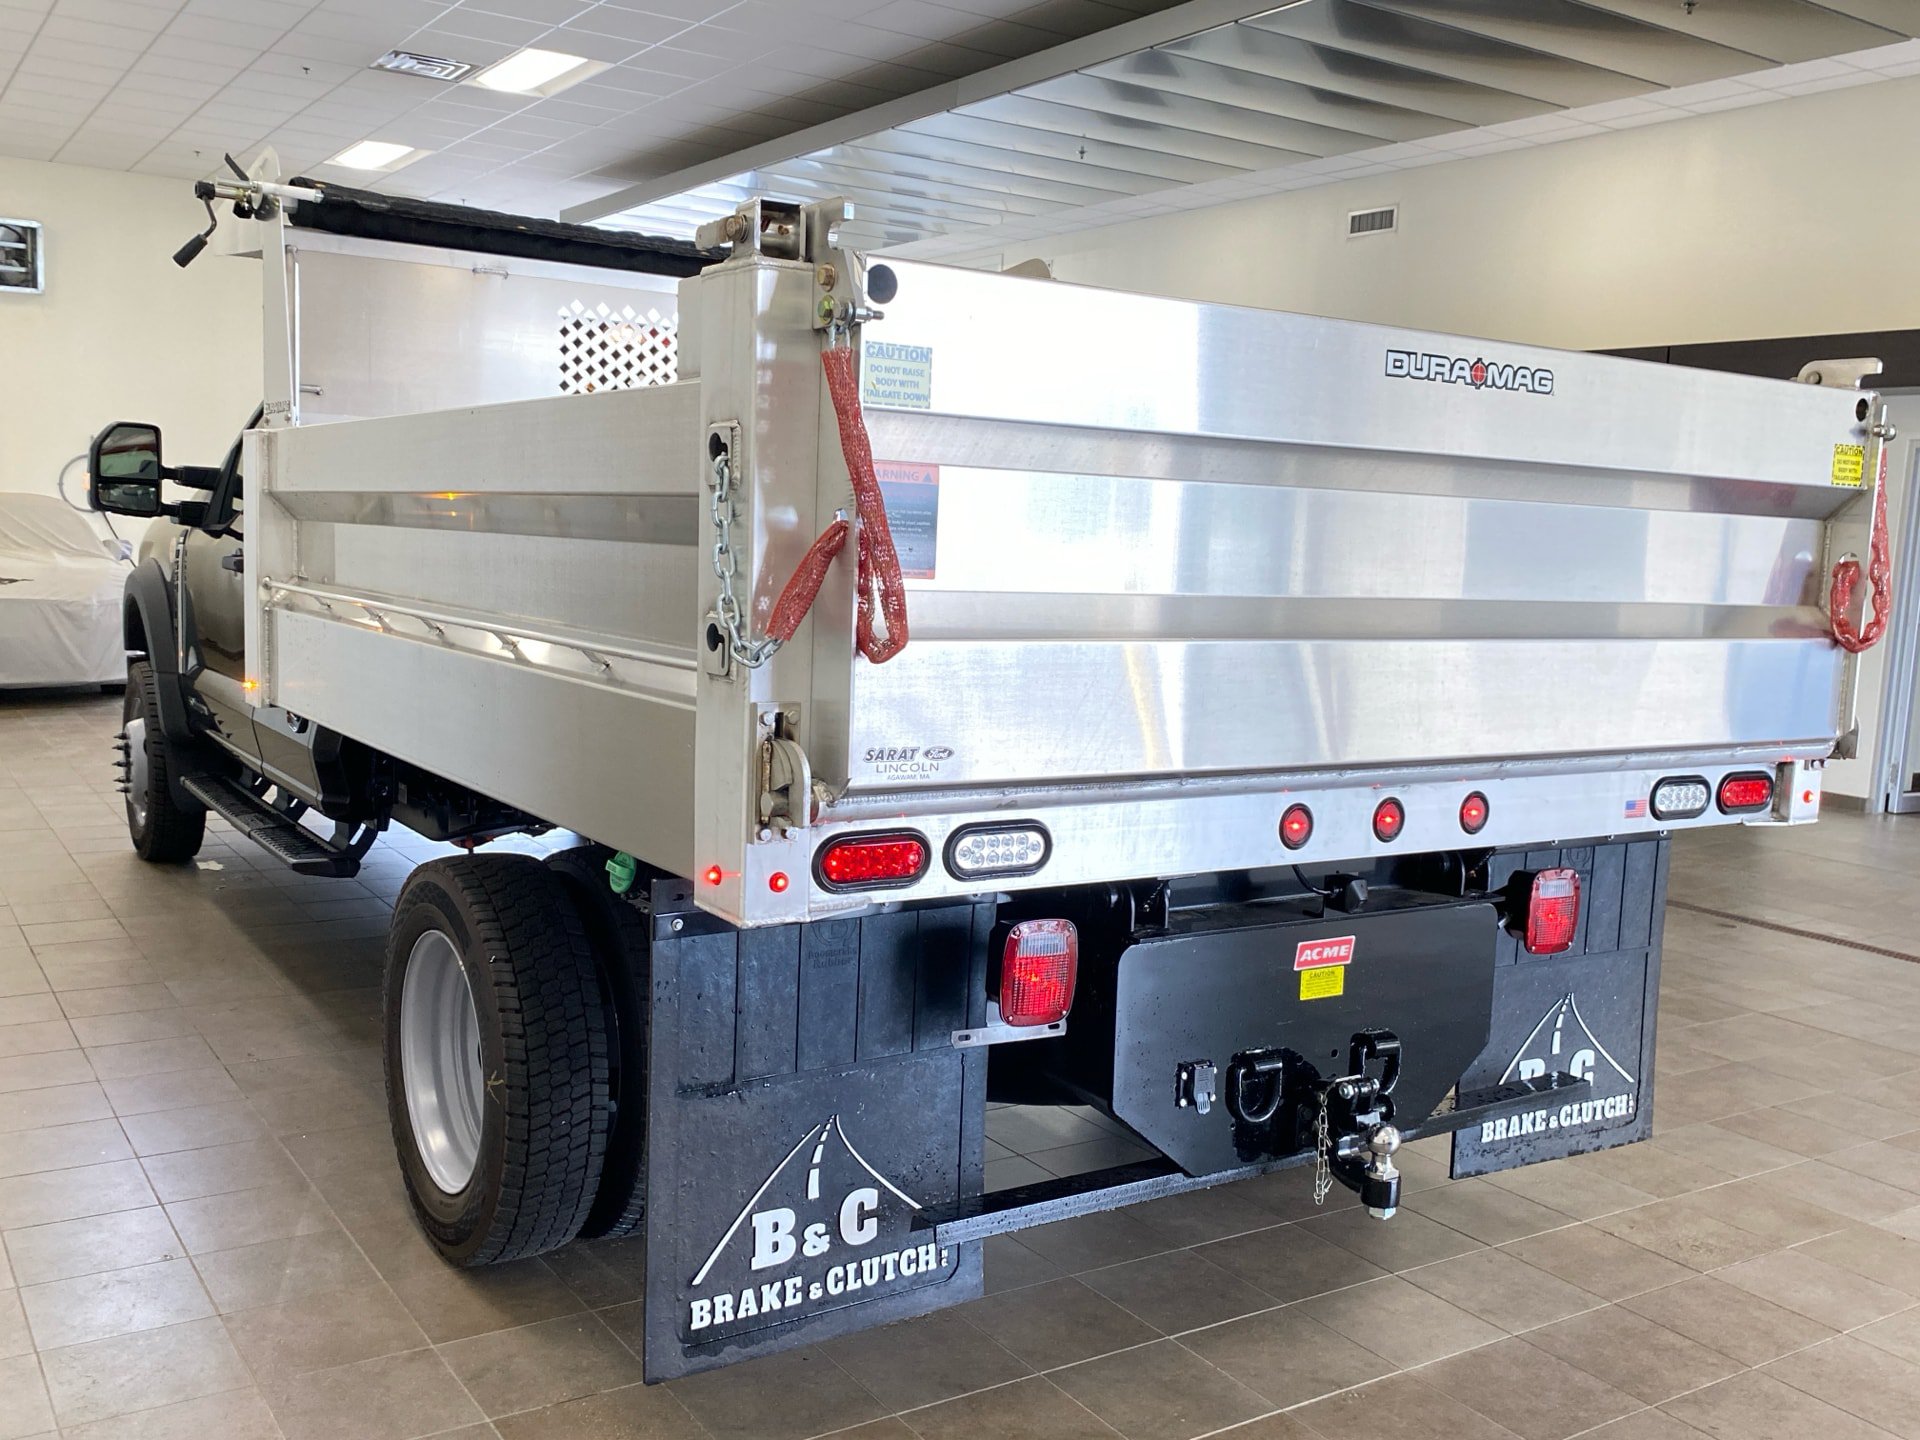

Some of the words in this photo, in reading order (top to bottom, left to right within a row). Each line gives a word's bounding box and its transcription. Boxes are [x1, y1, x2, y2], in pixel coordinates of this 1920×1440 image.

[866, 344, 930, 362] CAUTION
[870, 364, 883, 373] DO
[884, 366, 901, 375] NOT
[902, 367, 925, 377] RAISE
[875, 376, 898, 387] BODY
[899, 379, 919, 389] WITH
[865, 388, 902, 399] TAILGATE
[903, 391, 928, 402] DOWN
[1836, 446, 1862, 457] CAUTION
[876, 468, 919, 480] ARNING
[863, 747, 920, 763] SARAT
[925, 747, 953, 761] Ford
[876, 762, 939, 774] LINCOLN
[1300, 944, 1351, 962] ACME
[1481, 1110, 1547, 1143] BRAKE
[1559, 1094, 1629, 1127] CLUTCH
[690, 1276, 803, 1330] BRAKE
[809, 1282, 823, 1300] &
[826, 1243, 937, 1296] CLUTCH
